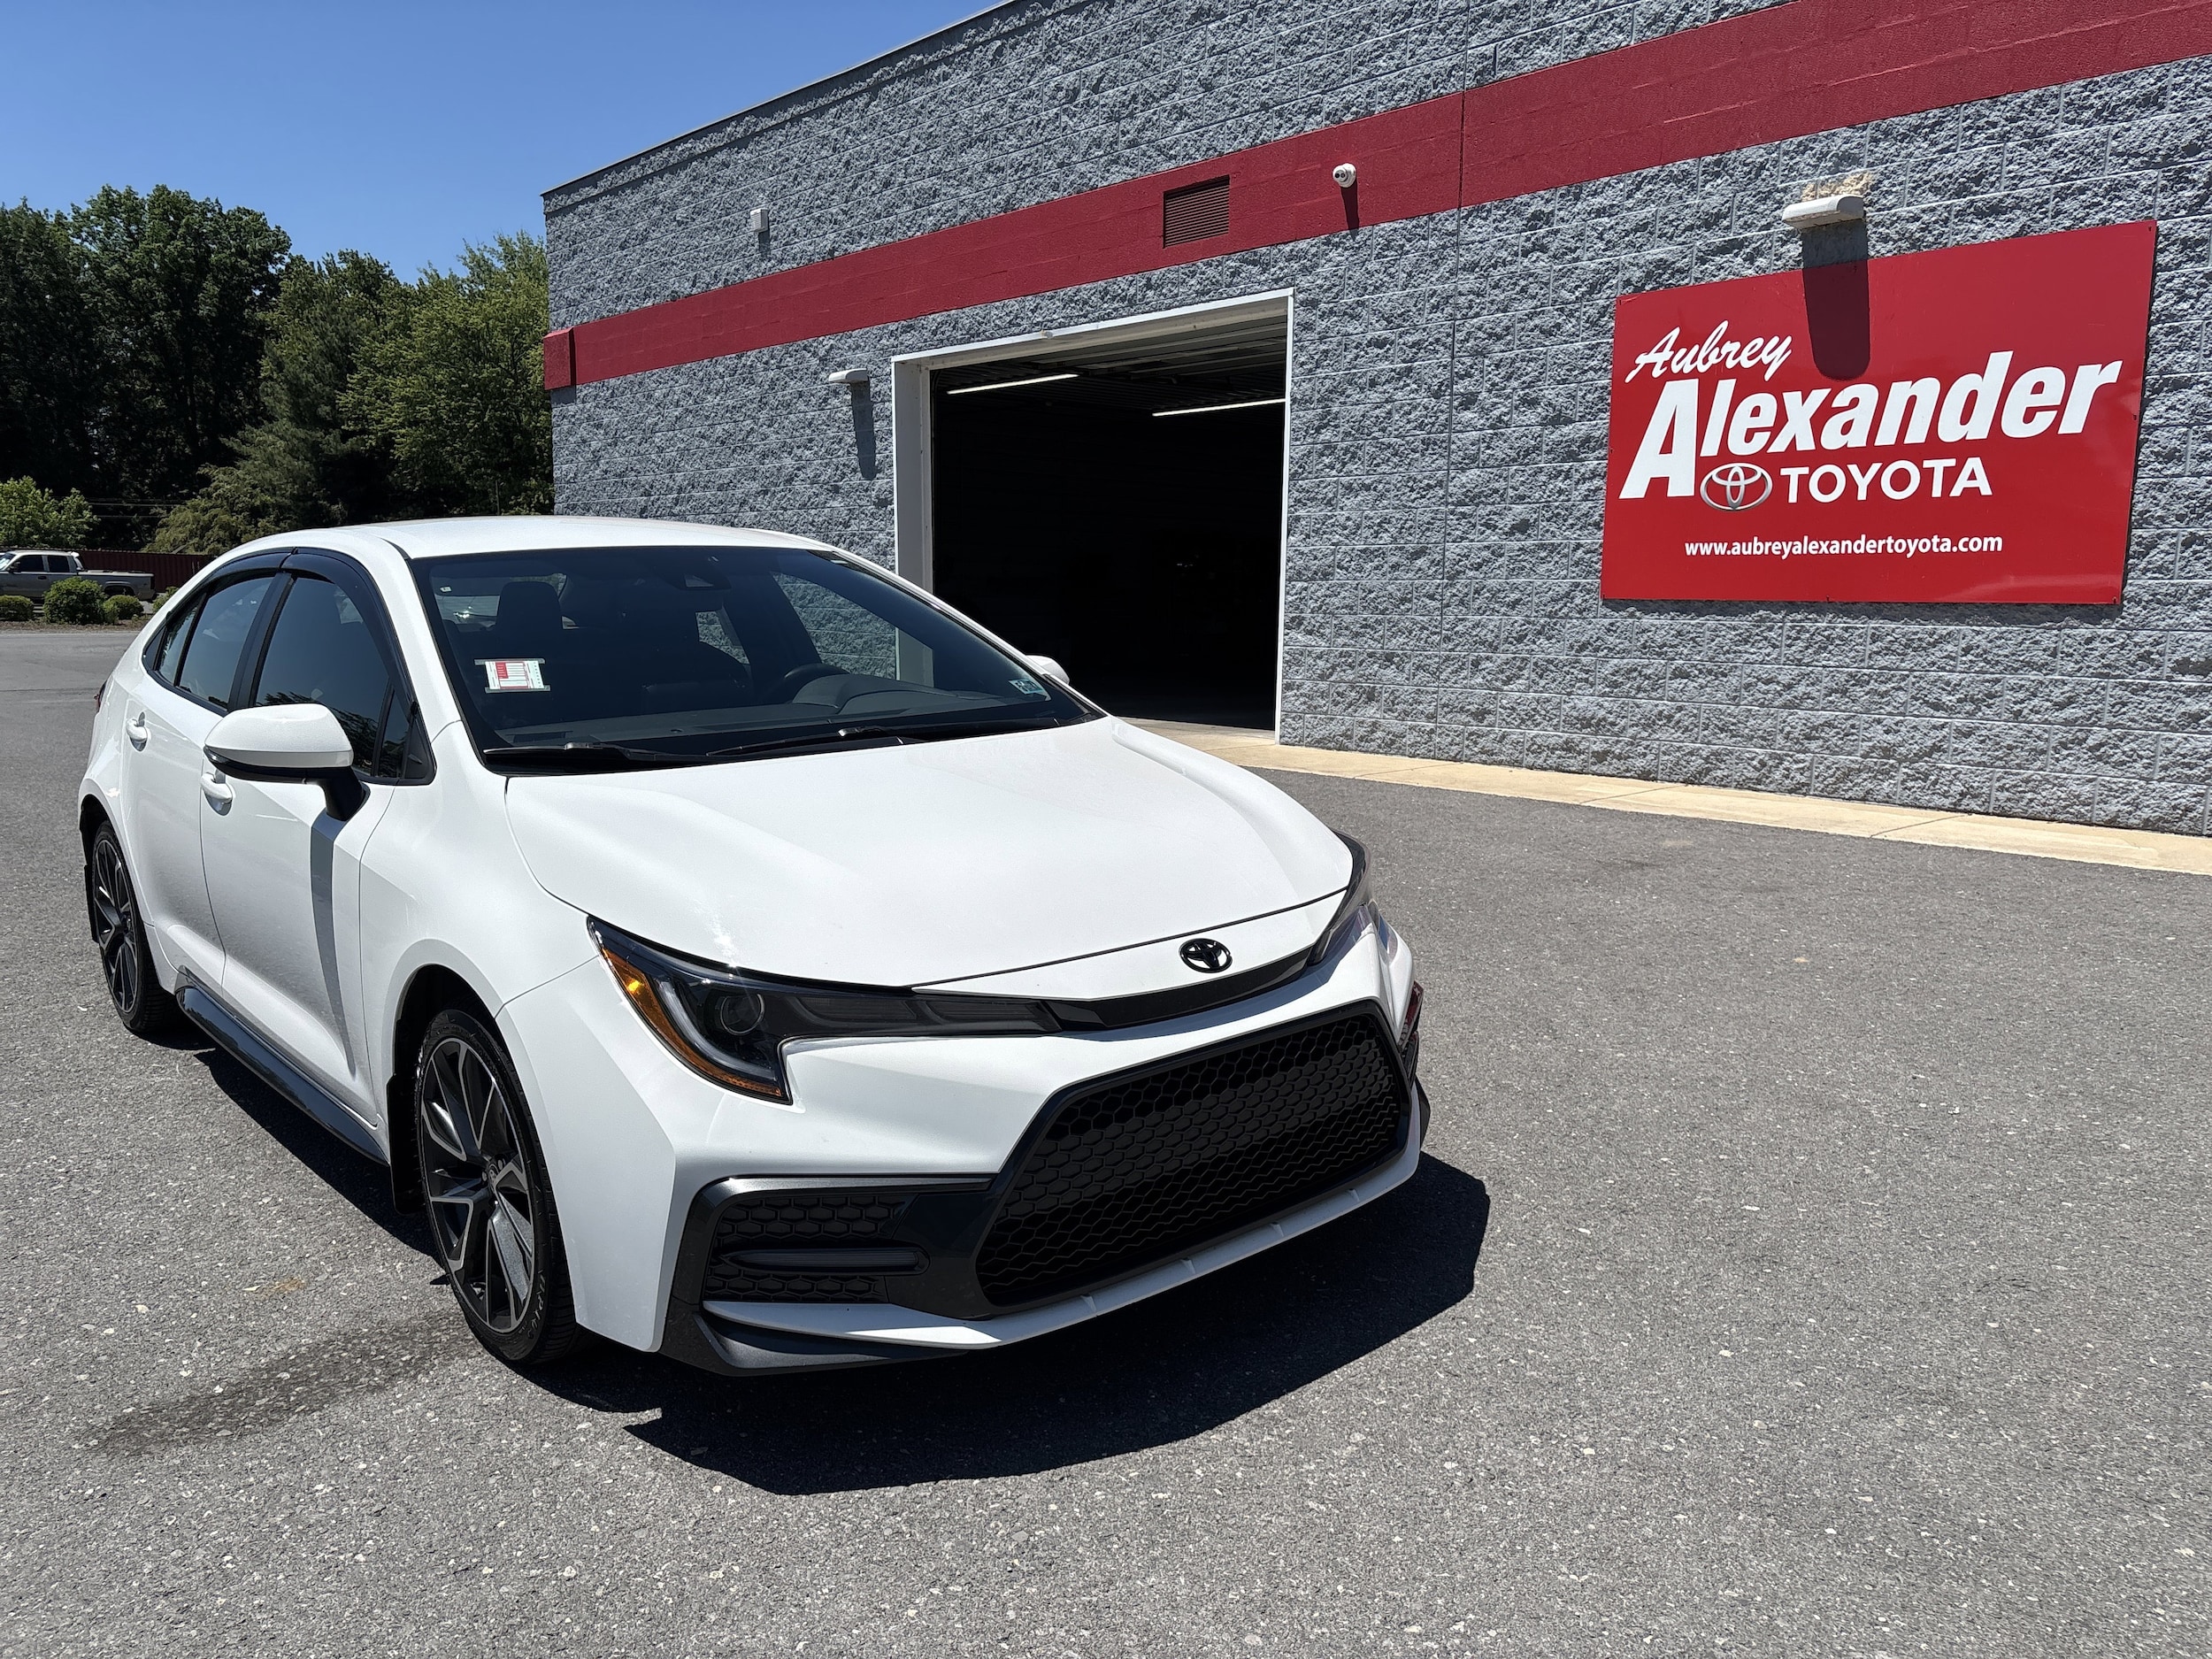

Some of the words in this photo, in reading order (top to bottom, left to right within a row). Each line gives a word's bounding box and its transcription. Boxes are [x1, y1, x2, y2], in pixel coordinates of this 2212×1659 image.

[1624, 319, 1793, 383] Aubrey
[1618, 350, 2124, 500] Alexander
[1779, 457, 1993, 503] TOYOTA
[1685, 534, 2003, 560] www.aubreyalexandertoyota.com
